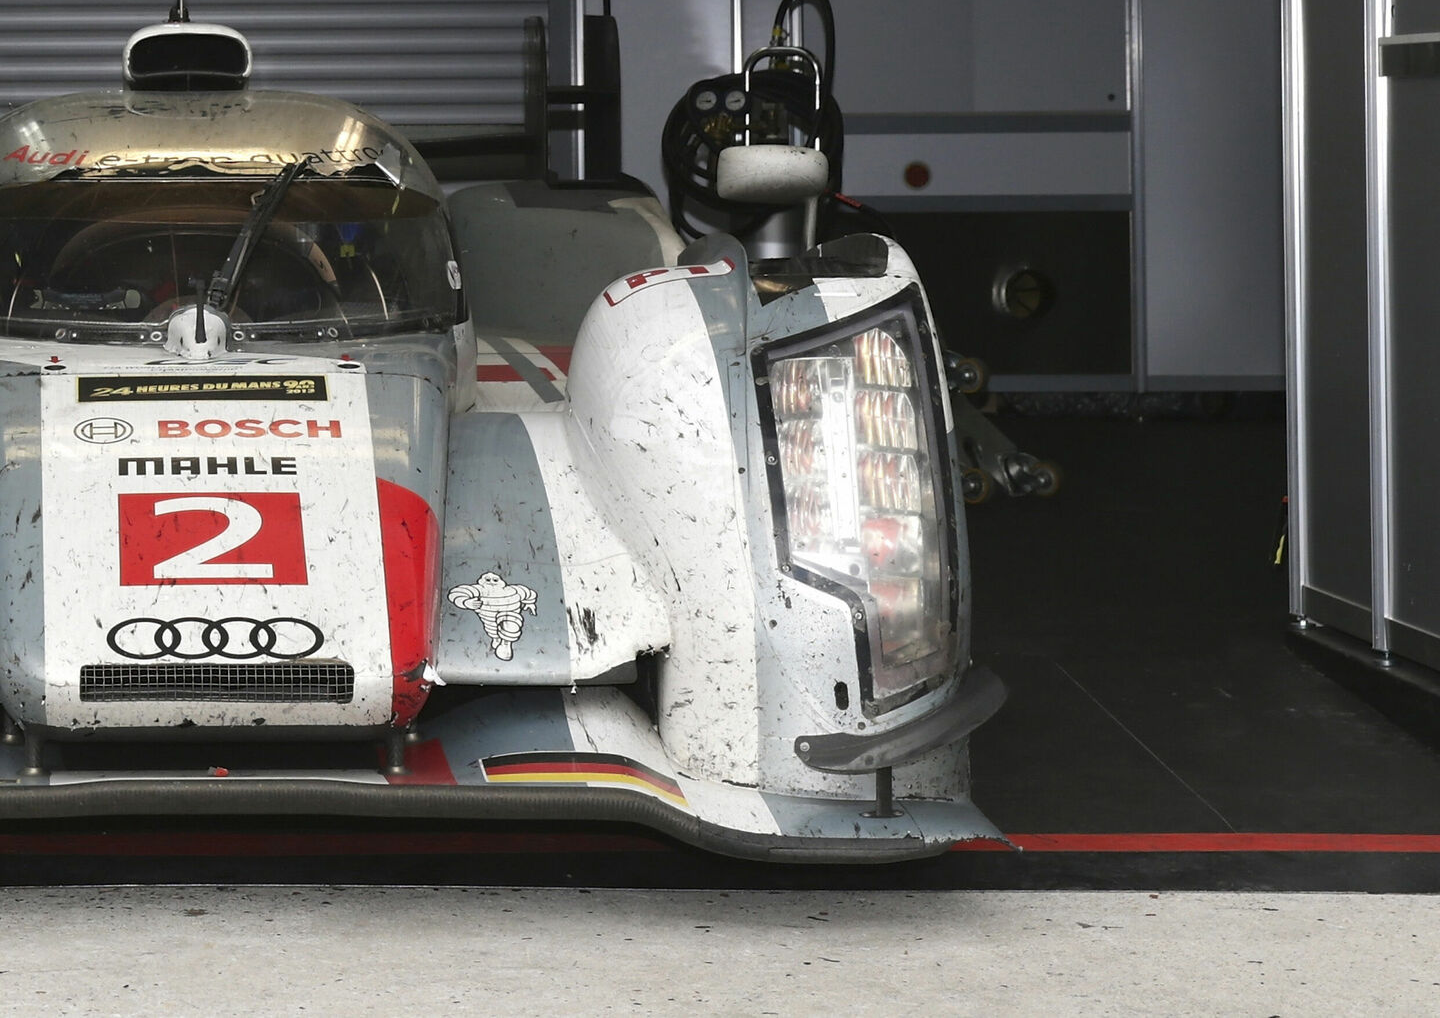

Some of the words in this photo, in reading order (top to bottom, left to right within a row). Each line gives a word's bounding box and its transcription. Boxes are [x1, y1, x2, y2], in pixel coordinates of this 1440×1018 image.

[3, 144, 90, 166] Audi
[90, 386, 135, 398] 24
[136, 383, 200, 394] HEURES
[203, 382, 229, 392] DU
[232, 380, 281, 390] MANS
[157, 419, 342, 438] BOSCH
[118, 456, 298, 476] MAHLE
[153, 496, 275, 579] 2
